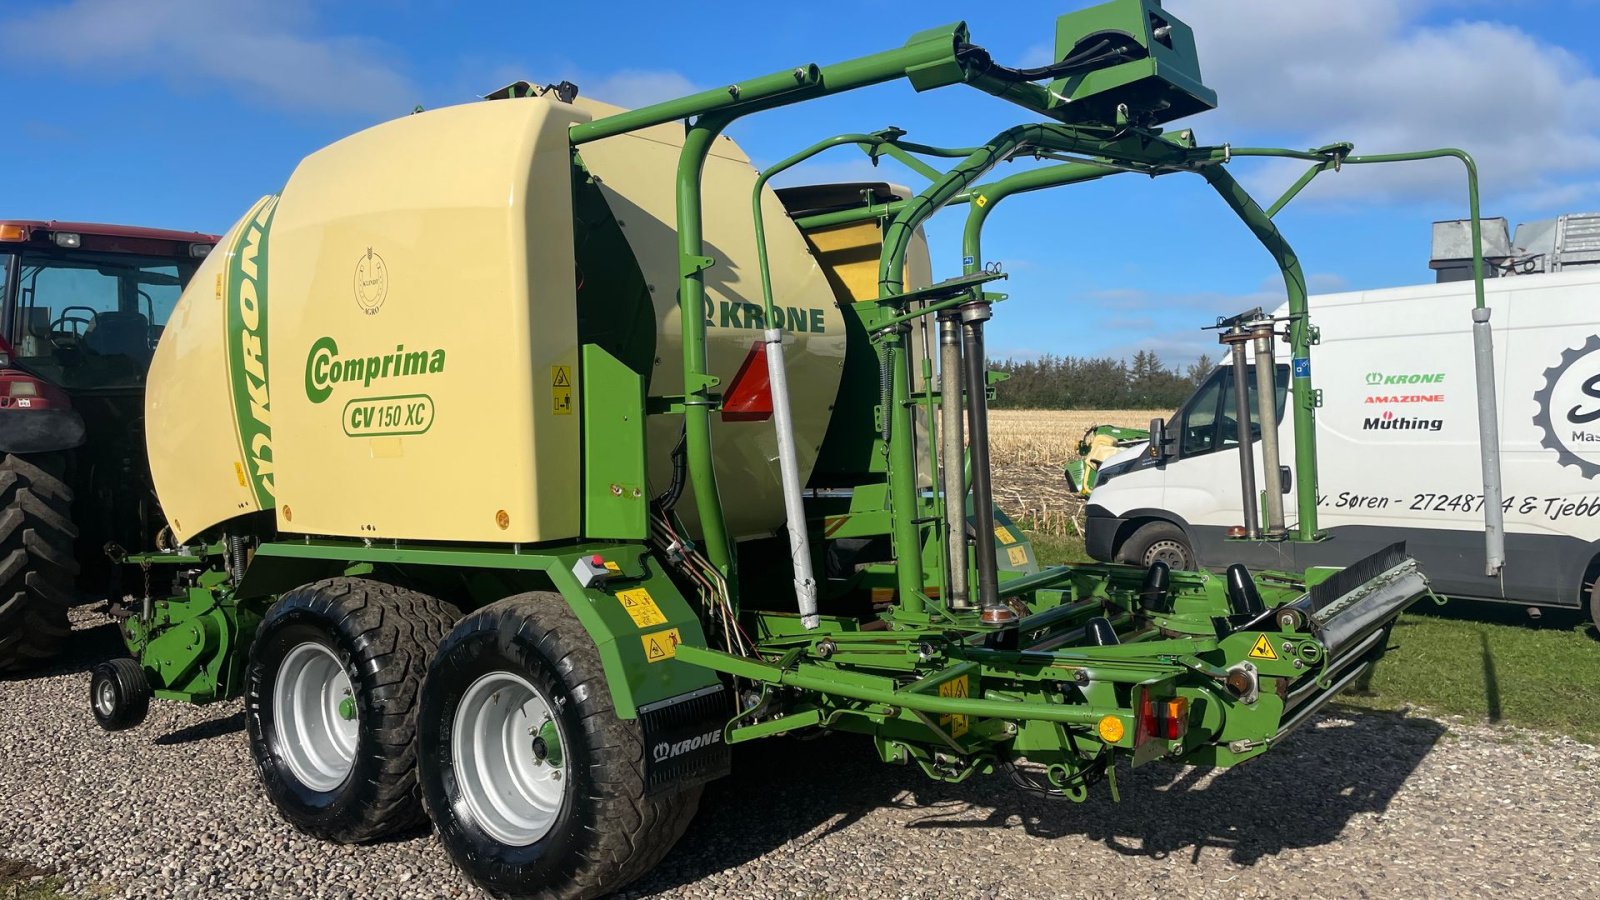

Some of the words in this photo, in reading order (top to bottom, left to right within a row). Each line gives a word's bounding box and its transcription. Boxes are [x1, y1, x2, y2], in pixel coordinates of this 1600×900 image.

[720, 301, 825, 333] KRONE
[305, 336, 446, 404] Comprima
[1384, 373, 1446, 385] KRONE
[1364, 395, 1445, 404] AMAZONE
[351, 406, 375, 429] CV
[378, 405, 402, 427] 150
[404, 402, 426, 426] XC
[1335, 491, 1389, 509] Søren
[1409, 494, 1516, 513] 2724874
[1519, 496, 1538, 514] &
[669, 729, 722, 758] KRONE
